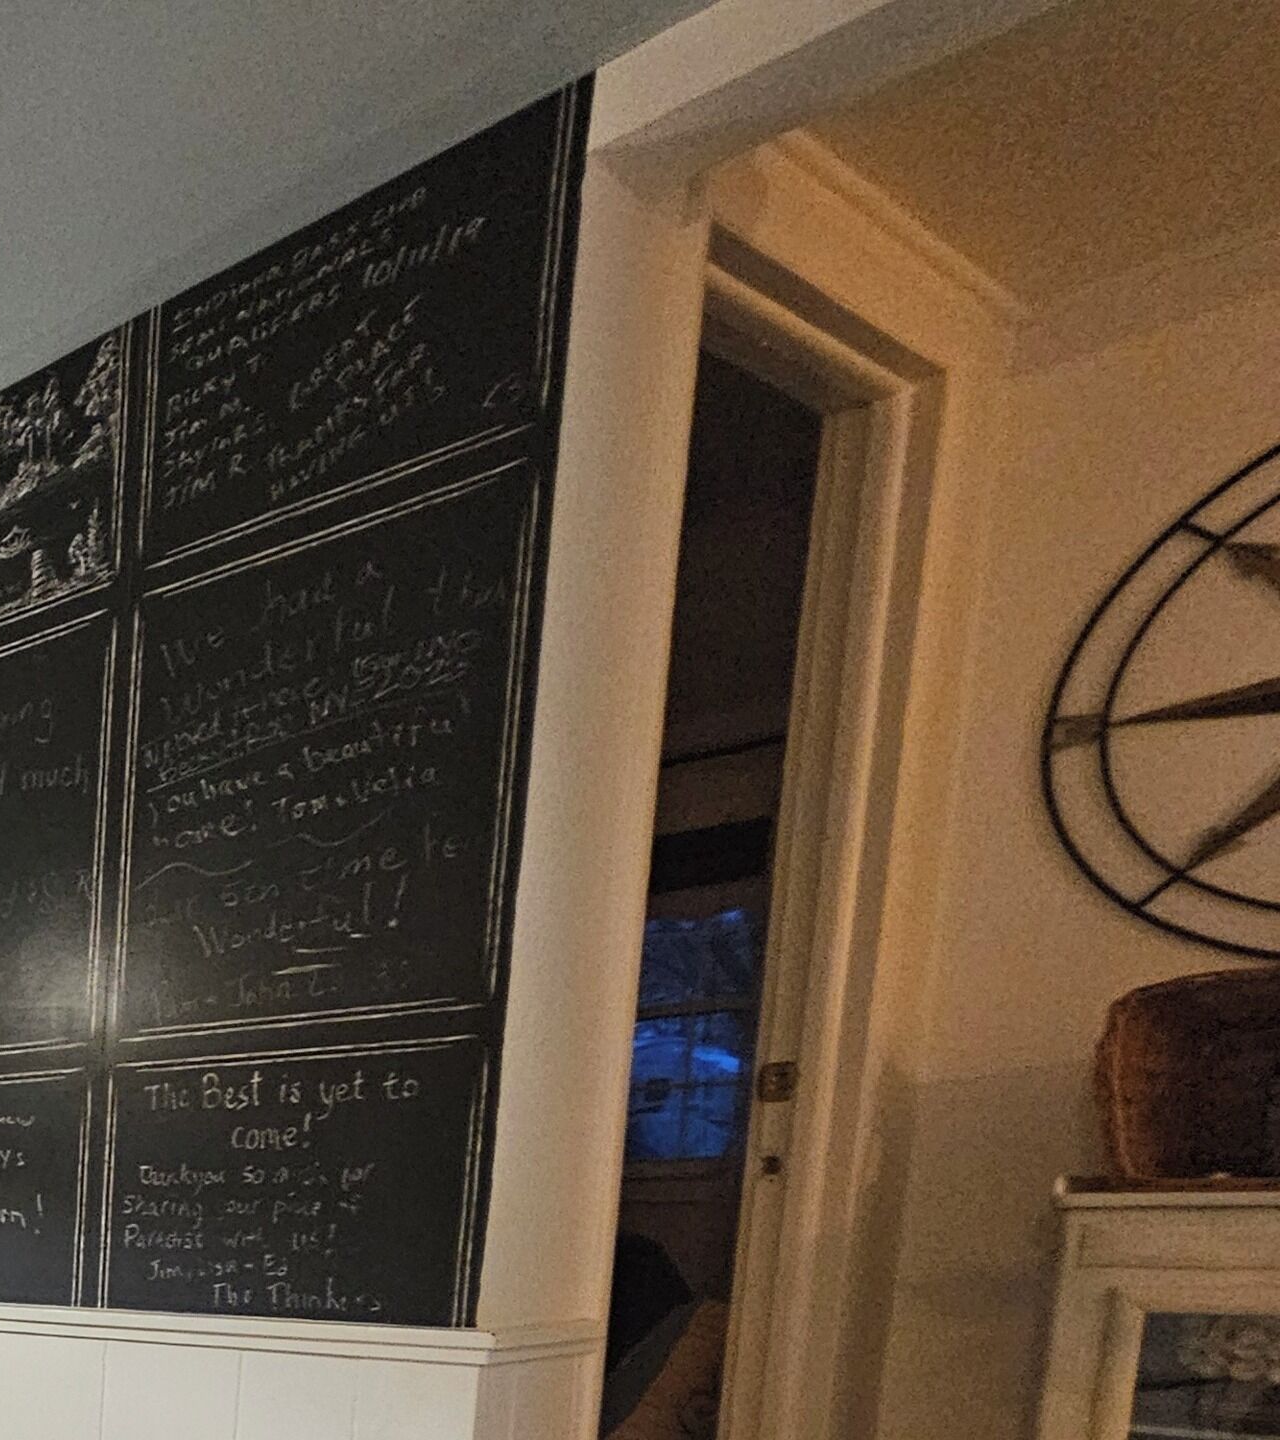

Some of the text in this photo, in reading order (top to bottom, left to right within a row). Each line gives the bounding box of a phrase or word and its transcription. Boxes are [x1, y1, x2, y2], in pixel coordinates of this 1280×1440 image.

[201, 1069, 264, 1112] Best
[278, 1073, 303, 1105] is
[316, 1069, 366, 1122] yet
[381, 1070, 420, 1102] to
